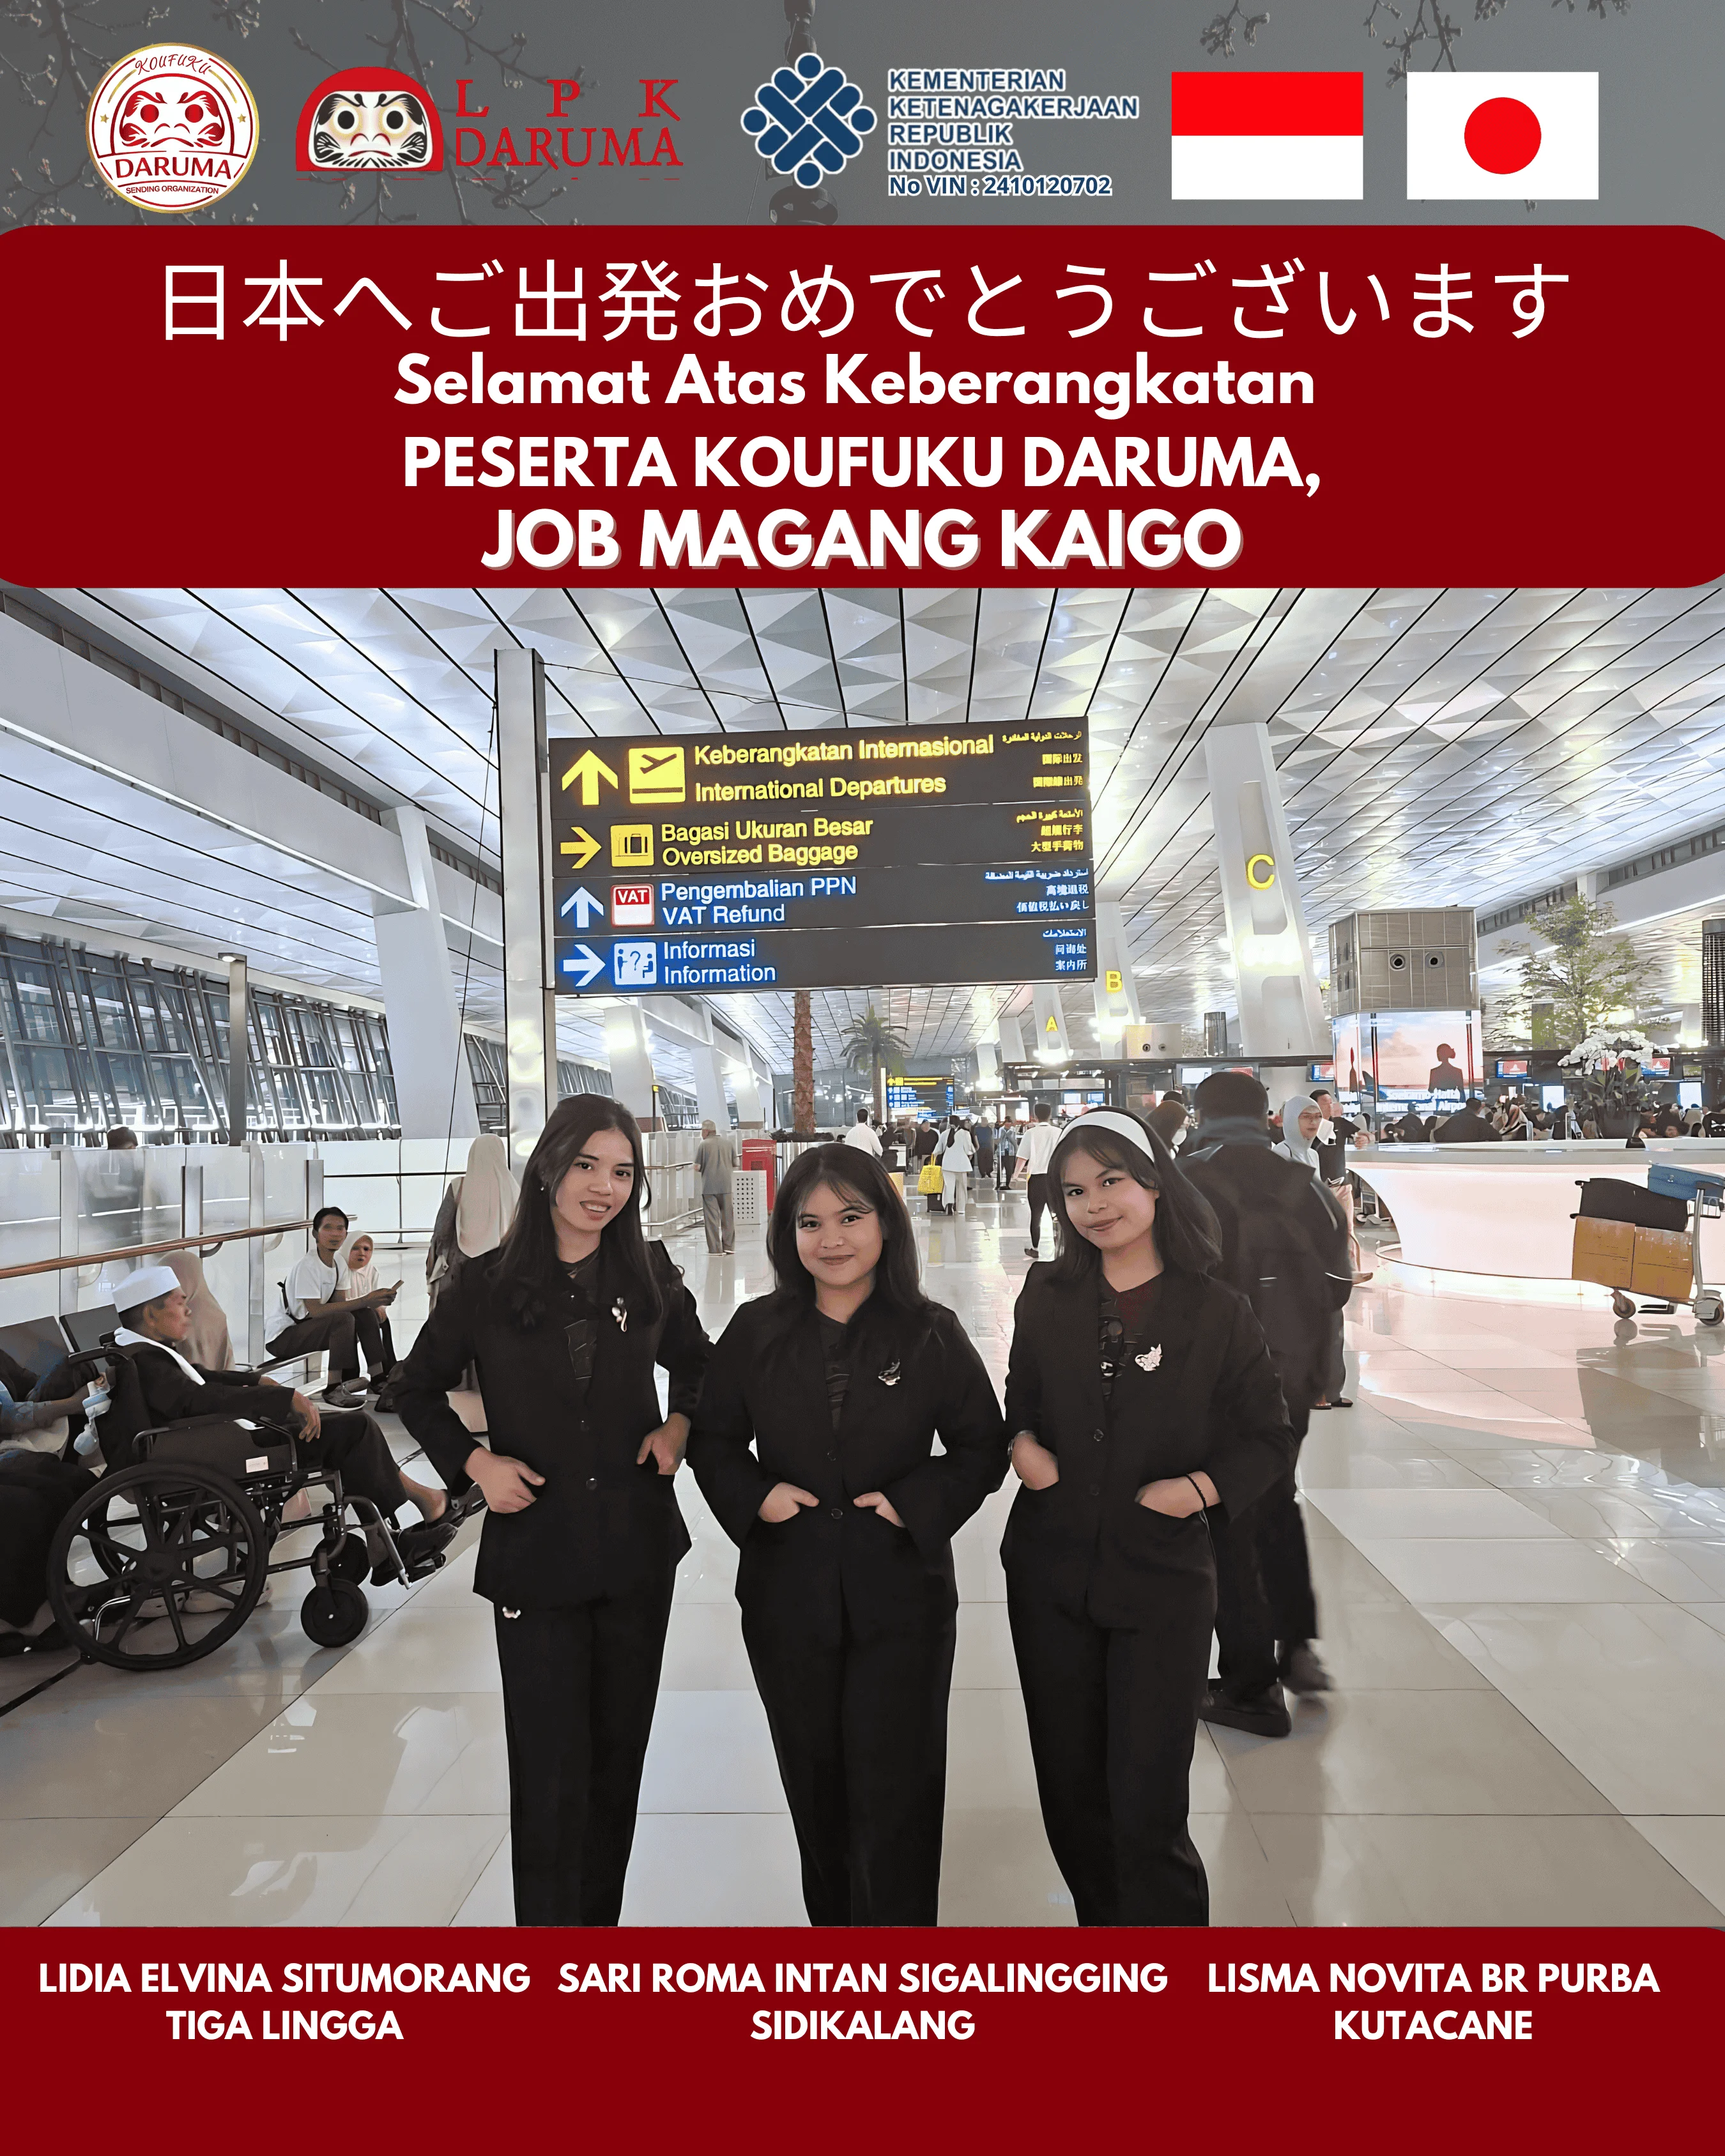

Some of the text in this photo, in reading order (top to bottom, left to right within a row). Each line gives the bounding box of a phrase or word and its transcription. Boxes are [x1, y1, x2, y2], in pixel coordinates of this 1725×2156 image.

[695, 734, 994, 767] Keberangkatan Internasional
[695, 776, 946, 802] International Departures
[661, 817, 873, 846] Bagasi Ukuran Besar
[663, 844, 858, 866] Oversized Baggage
[1246, 854, 1275, 890] C
[618, 889, 647, 903] VAT
[661, 876, 856, 904] Pengembalian PPN
[663, 903, 785, 925] VAT Refund
[664, 938, 755, 959] Informasi
[664, 964, 776, 984] Information
[1106, 971, 1123, 993] B
[1046, 1016, 1058, 1032] A
